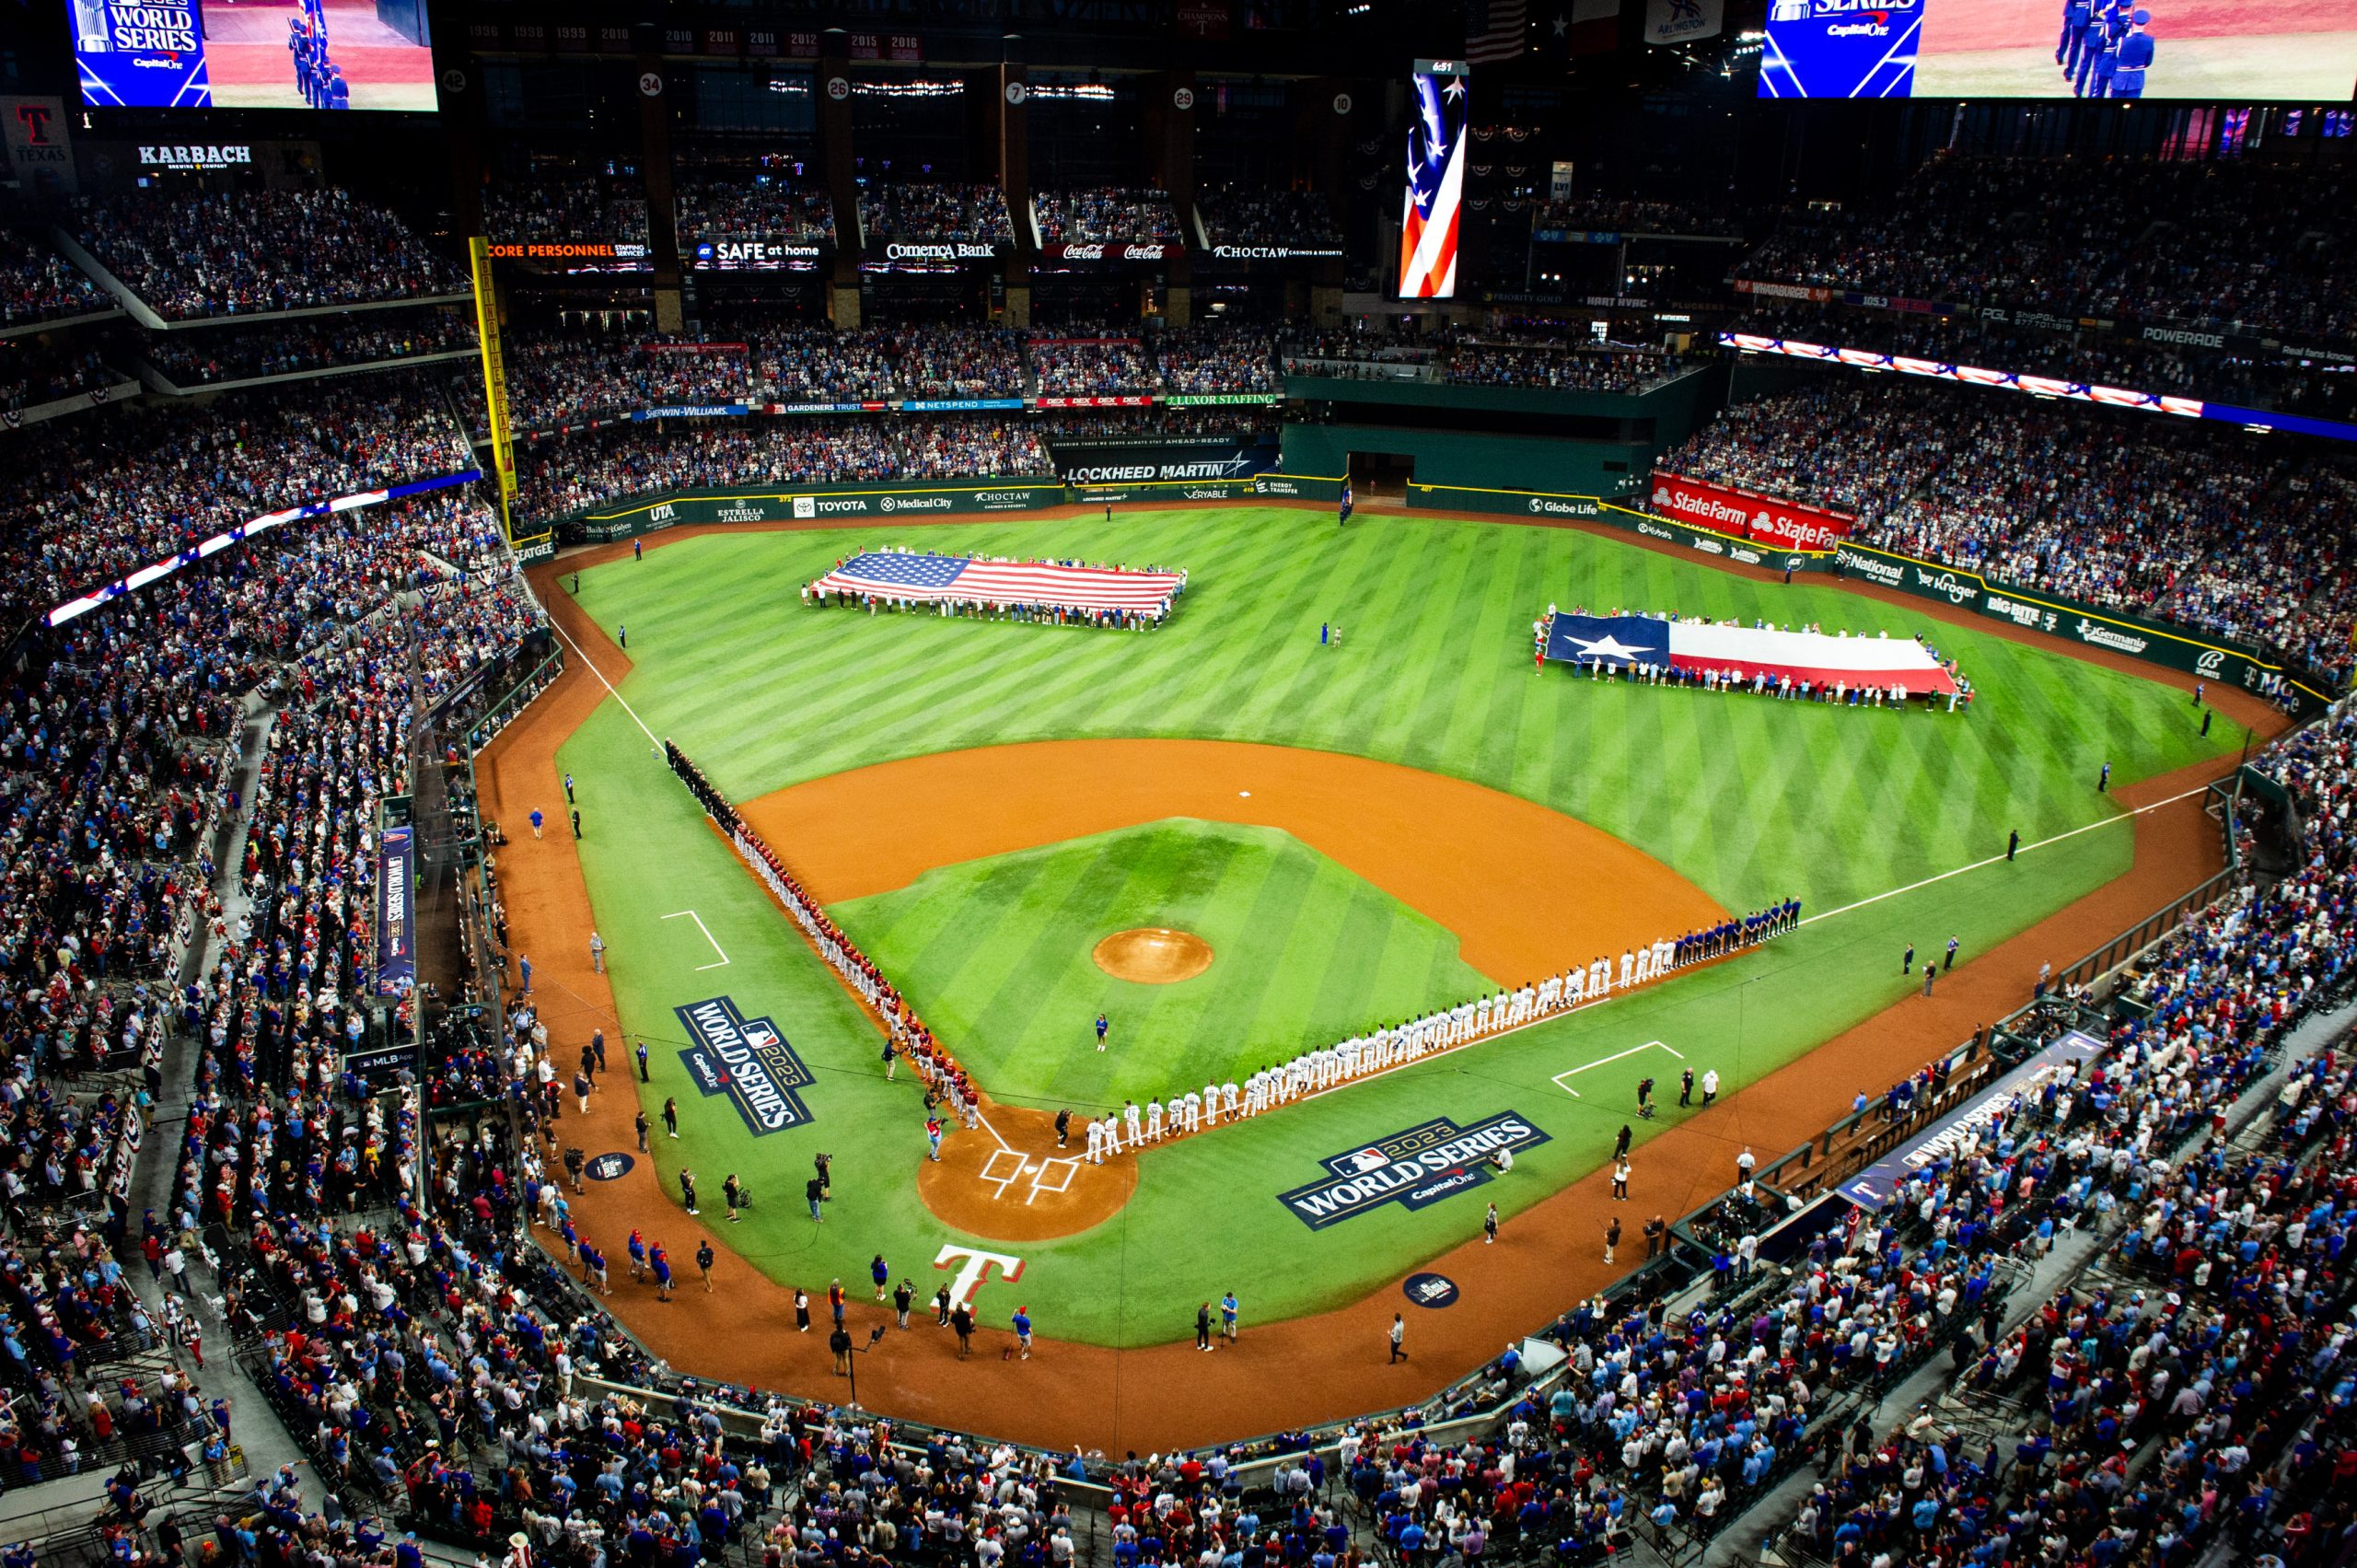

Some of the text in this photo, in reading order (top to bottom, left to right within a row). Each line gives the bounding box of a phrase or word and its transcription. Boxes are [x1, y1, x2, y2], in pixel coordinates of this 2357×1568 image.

[110, 6, 192, 29] WORLD
[1658, 18, 1706, 33] ARLINGTON
[115, 28, 196, 52] SERIES
[601, 28, 632, 41] 2010
[666, 29, 692, 42] 2010
[709, 30, 735, 43] 2011
[750, 32, 774, 45] 2011
[791, 33, 818, 46] 2012
[851, 35, 877, 48] 2015
[890, 36, 918, 49] 2016
[1433, 61, 1453, 73] 6:51
[642, 77, 660, 91] 34
[830, 82, 846, 96] 26
[1011, 87, 1020, 100] 7
[1176, 93, 1191, 106] 29
[1337, 98, 1349, 110] 10
[17, 148, 66, 163] TEXAS
[138, 145, 251, 164] KARBACH
[528, 244, 615, 257] PERSONNEL
[717, 243, 765, 260] SAFE
[768, 246, 783, 256] at
[785, 244, 819, 256] home
[957, 243, 994, 258] Bank
[1222, 245, 1288, 258] CHOCTAW
[1493, 292, 1562, 304] PRIORITY GOLD
[1752, 282, 1810, 300] WHATABURGER
[1586, 296, 1648, 308] HART HVAC
[1863, 296, 1888, 308] 105.3
[1981, 307, 2009, 321] PGL
[2142, 327, 2224, 349] POWERADE
[2282, 344, 2304, 356] Real
[2305, 346, 2325, 359] fans
[927, 401, 978, 410] NETSPEND
[1175, 395, 1274, 405] LUXOR STAFFING
[787, 403, 835, 412] GARDENERS
[1067, 463, 1224, 482] LOCKHEED MARTIN
[897, 497, 953, 509] Medical City
[981, 492, 1030, 503] CHOCTAW
[650, 504, 675, 521] UTA
[718, 508, 764, 517] ESTRELLA
[818, 501, 867, 512] TOYOTA
[1545, 501, 1597, 516] Globe Life
[722, 515, 761, 523] JALISCO
[586, 525, 607, 536] Baile
[1850, 554, 1904, 580] National
[1866, 572, 1899, 587] Car Rental
[1933, 573, 1978, 603] Kroger
[2010, 603, 2040, 622] BITE
[2096, 626, 2147, 649] Germania
[2195, 667, 2222, 680] SPORTS
[388, 866, 405, 894] WORLD
[387, 893, 406, 922] SERIES
[692, 1002, 751, 1064] WORLD
[373, 1054, 399, 1067] MLB
[762, 1046, 801, 1086] 2023
[729, 1062, 795, 1129] SERIES
[1384, 1124, 1456, 1158] 2023
[1294, 1120, 1532, 1217] WORLD SERIES
[930, 1244, 1027, 1318] T
